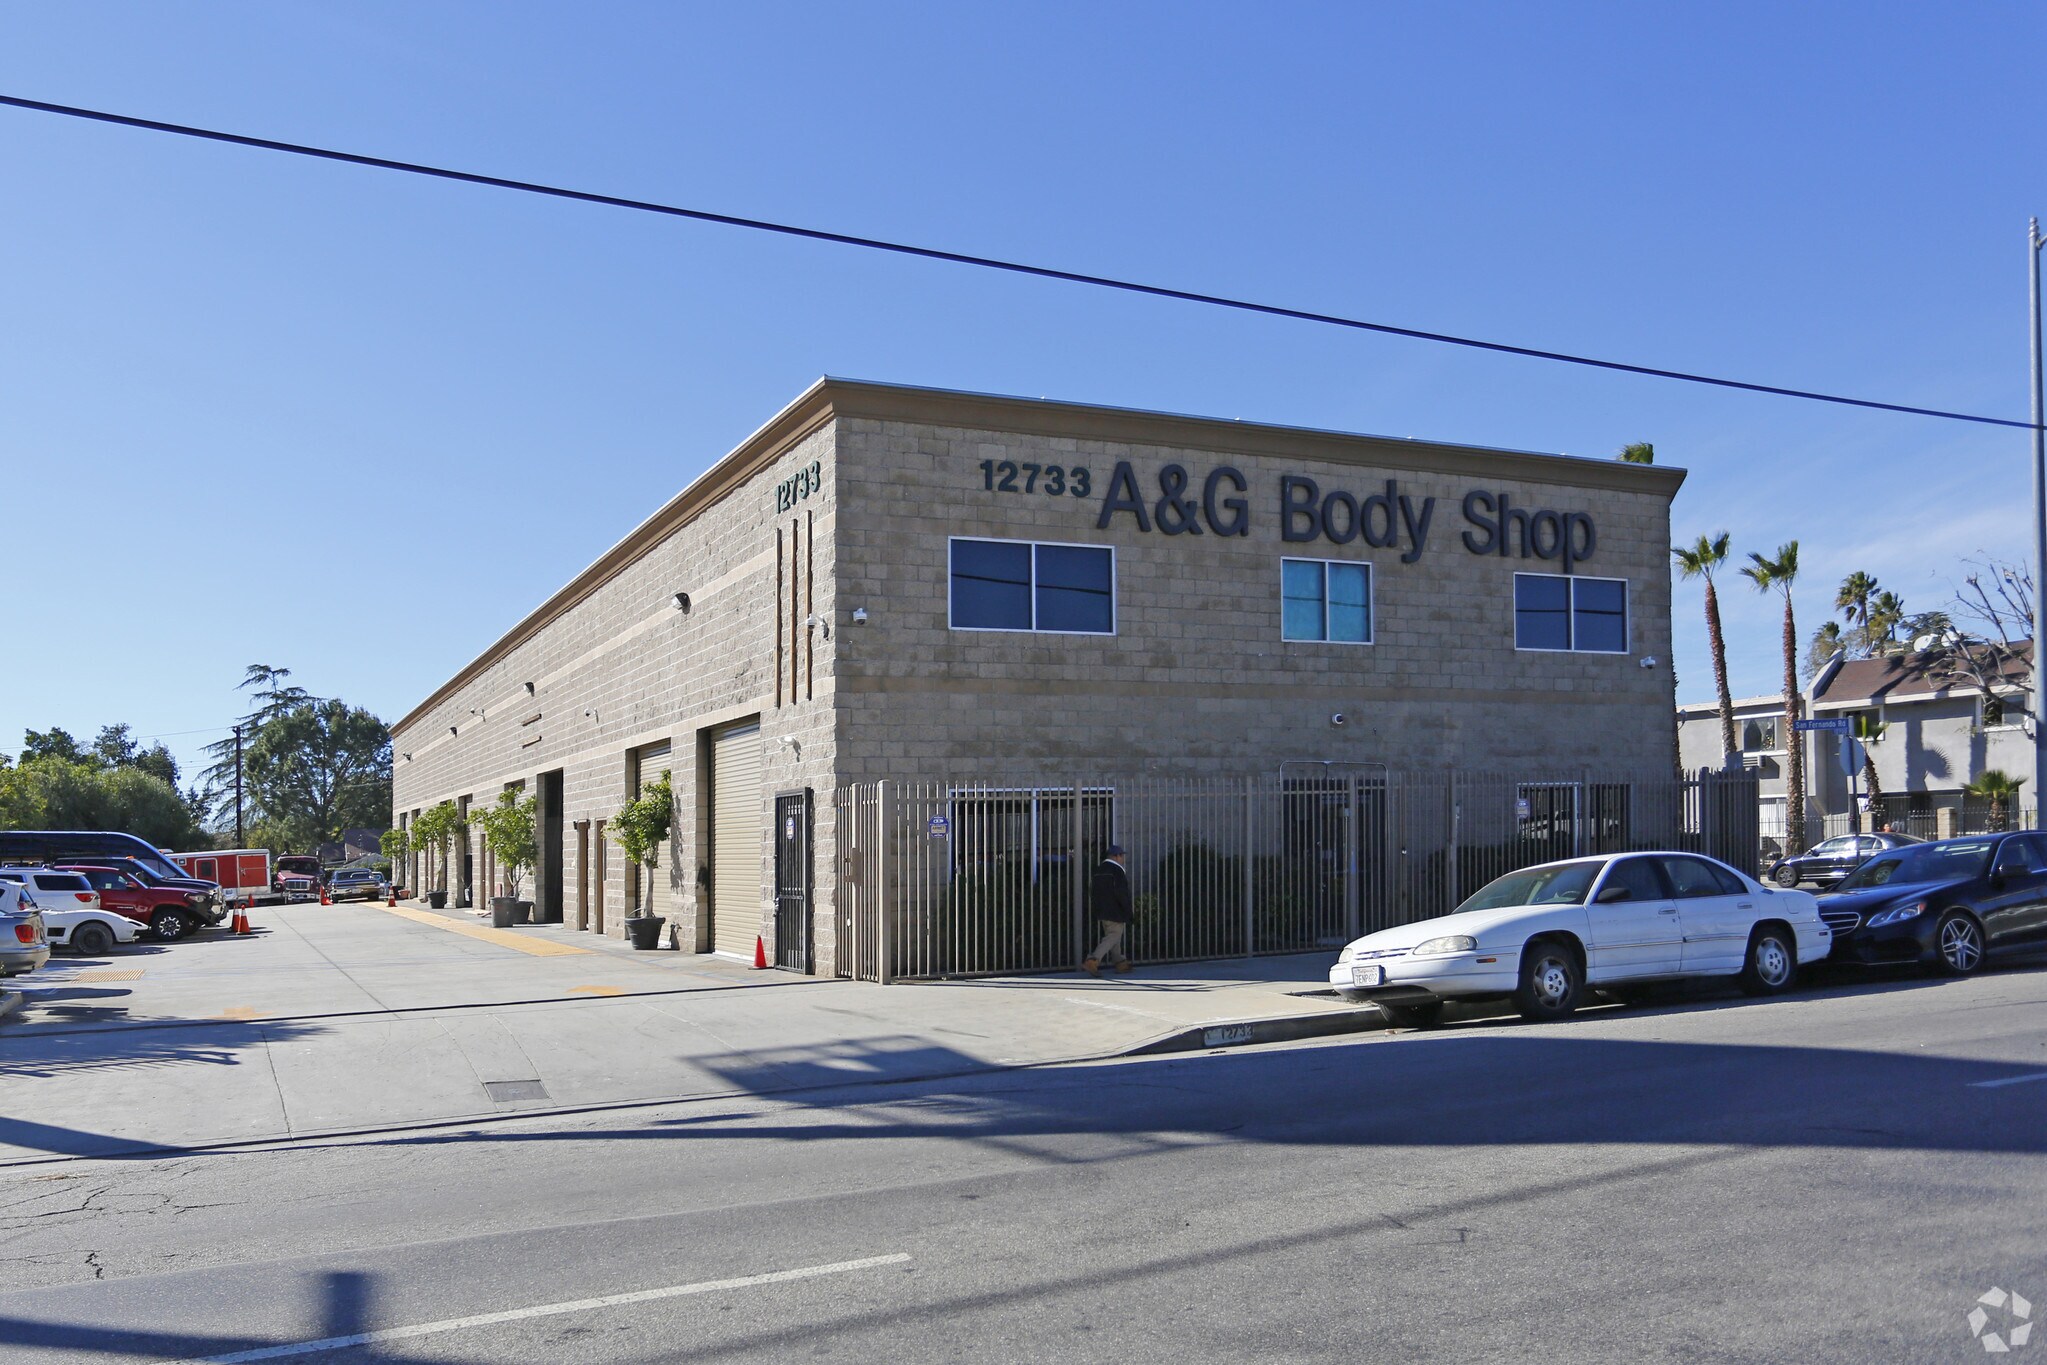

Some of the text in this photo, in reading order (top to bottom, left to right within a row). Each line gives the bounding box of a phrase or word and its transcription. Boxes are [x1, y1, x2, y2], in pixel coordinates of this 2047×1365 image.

[774, 459, 821, 514] 12733
[979, 459, 1091, 498] 12733
[1096, 461, 1597, 574] A&G Body Shop
[1795, 719, 1846, 729] San Fernando Rd
